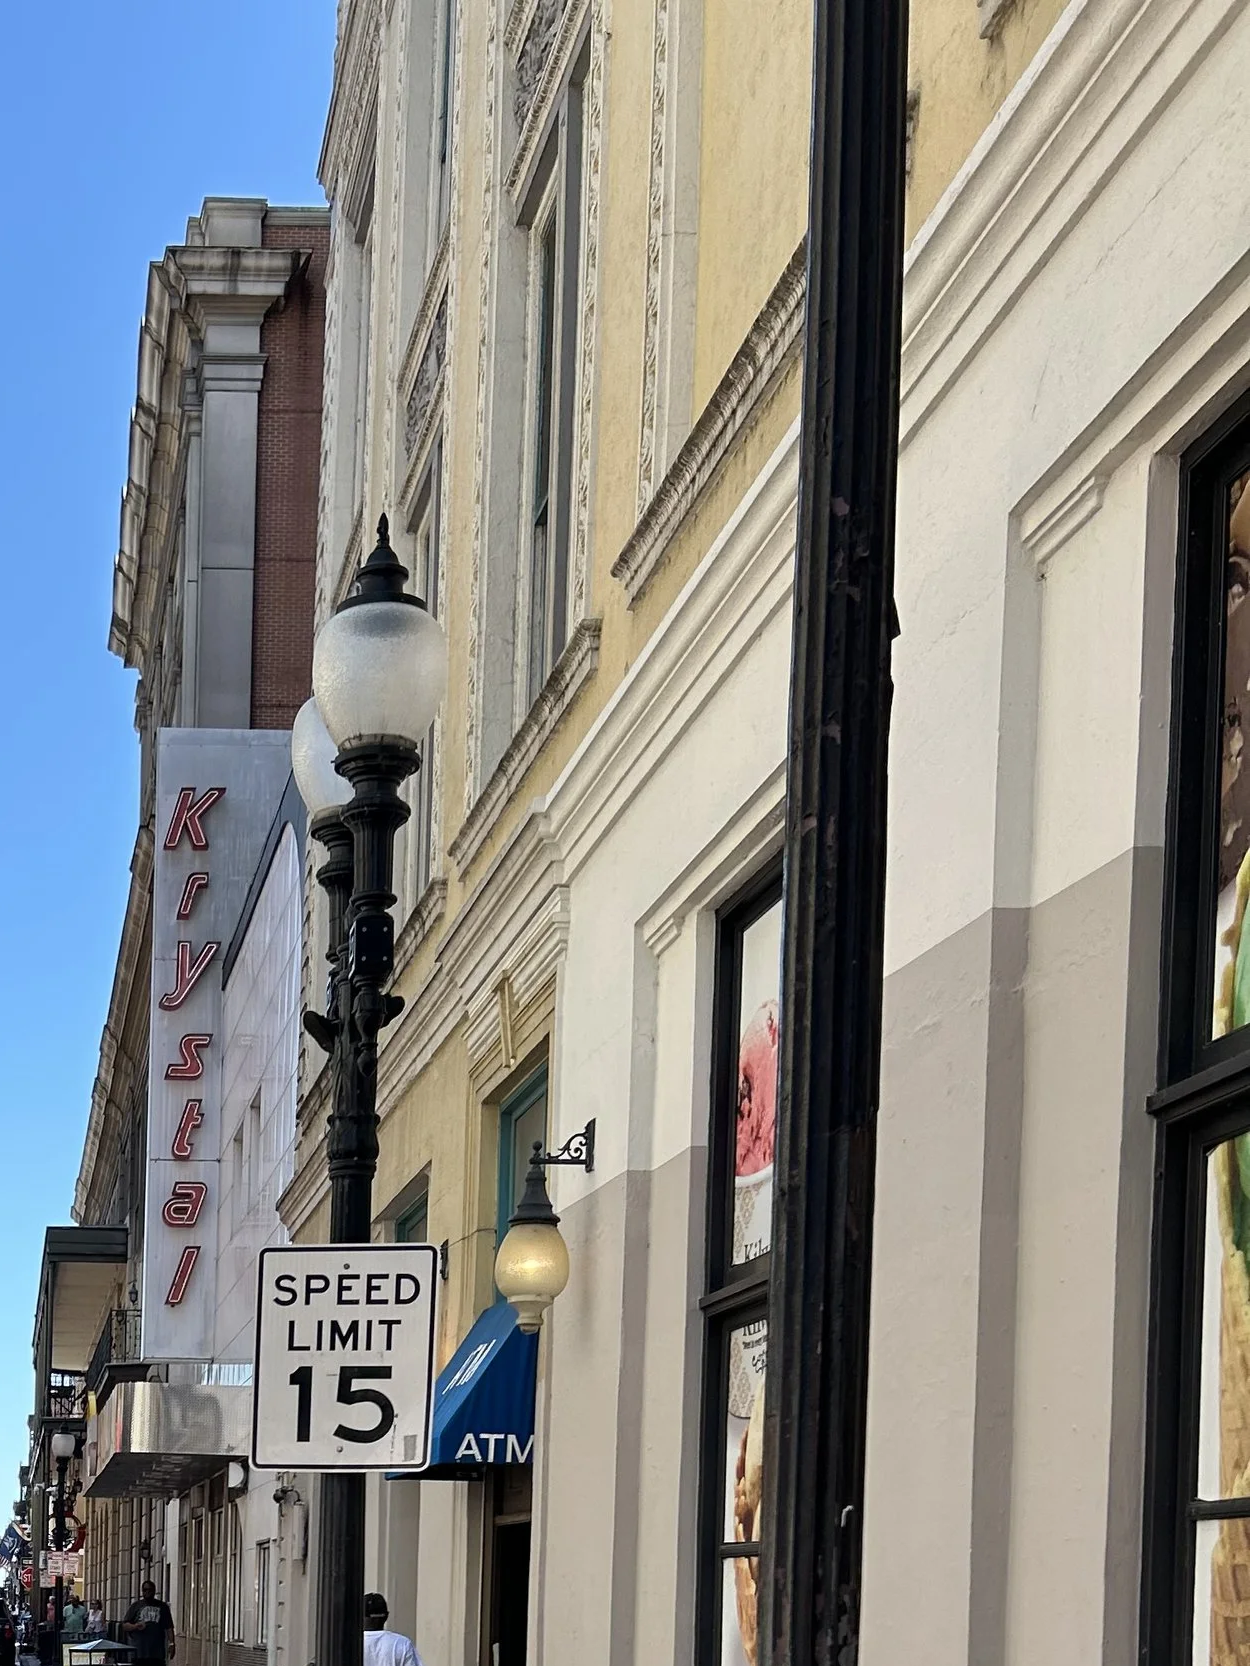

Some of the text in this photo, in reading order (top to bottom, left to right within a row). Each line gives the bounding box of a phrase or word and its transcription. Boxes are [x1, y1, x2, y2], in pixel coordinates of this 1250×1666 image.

[159, 787, 226, 1306] Krystal
[273, 1273, 421, 1306] SPEED
[288, 1319, 402, 1352] LIMIT
[442, 1339, 496, 1395] ATM
[289, 1365, 395, 1445] 15
[455, 1433, 534, 1463] ATM
